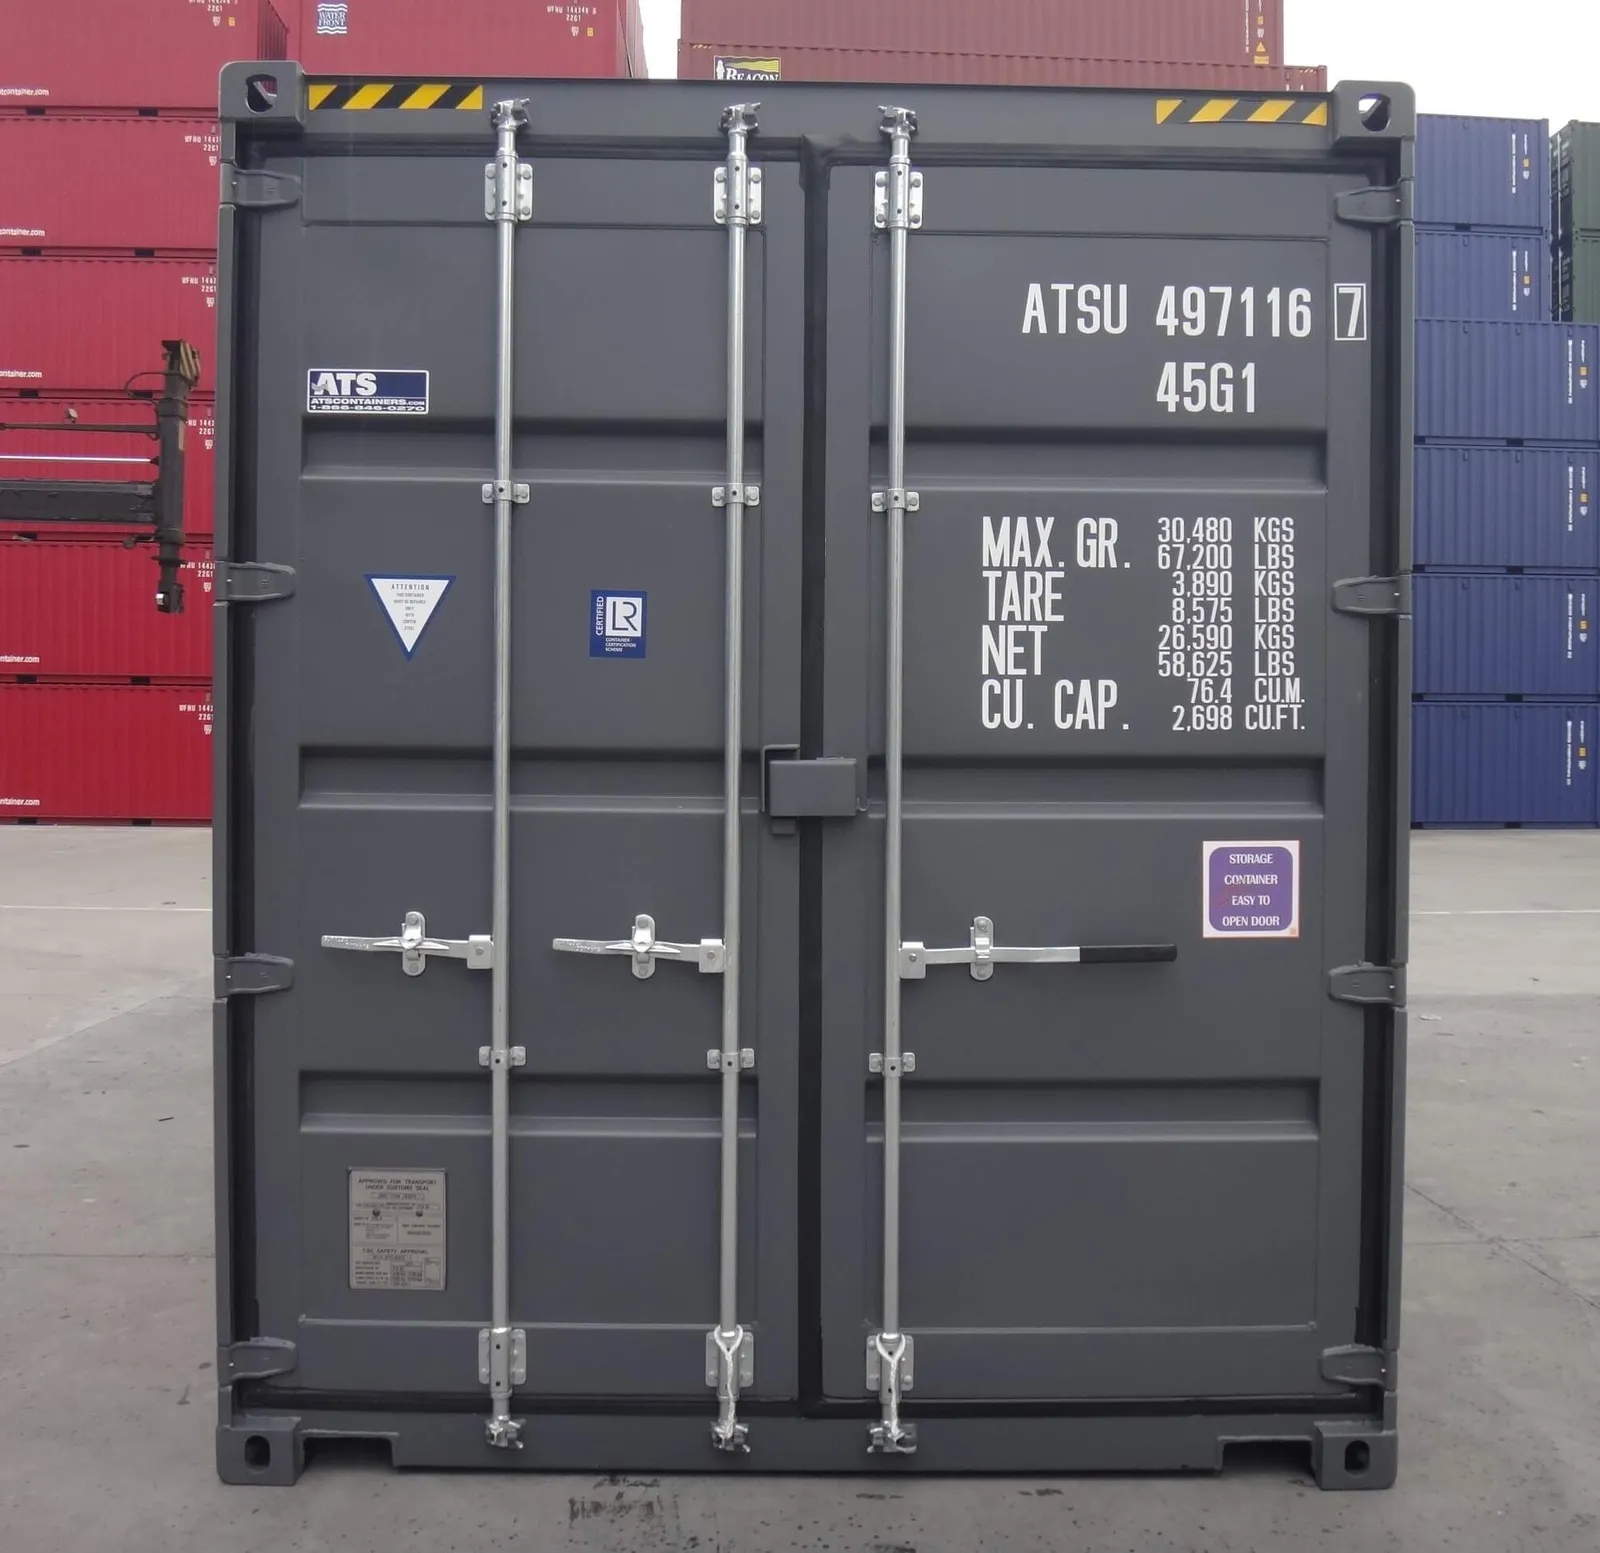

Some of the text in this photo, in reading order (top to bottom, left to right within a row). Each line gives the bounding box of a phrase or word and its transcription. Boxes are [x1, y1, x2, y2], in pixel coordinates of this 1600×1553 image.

[319, 11, 346, 19] WATER
[1022, 284, 1361, 337] ATSU 497116 7
[312, 373, 377, 396] ATS
[1157, 362, 1254, 412] 45G1
[983, 517, 1293, 568] MAX. GR. 30,480 KGS
[1159, 544, 1293, 570] 67,200 LBS
[983, 571, 1294, 621] TARE 3,890 KGS
[596, 596, 638, 636] CERTIFIED LR
[1173, 598, 1294, 624] 8,575 LBS
[982, 625, 1294, 675] NET 26,590 KGS
[1159, 651, 1294, 677] 58,625 LBS
[982, 678, 1304, 729] CU. CAP. 76.4 CU.M.
[1173, 705, 1304, 731] 2,698 CU.FT.
[1229, 853, 1274, 864] STORAGE
[1224, 874, 1278, 885] CONTAINER
[1232, 895, 1271, 906] EASY TO
[1222, 915, 1280, 927] OPEN DOOR
